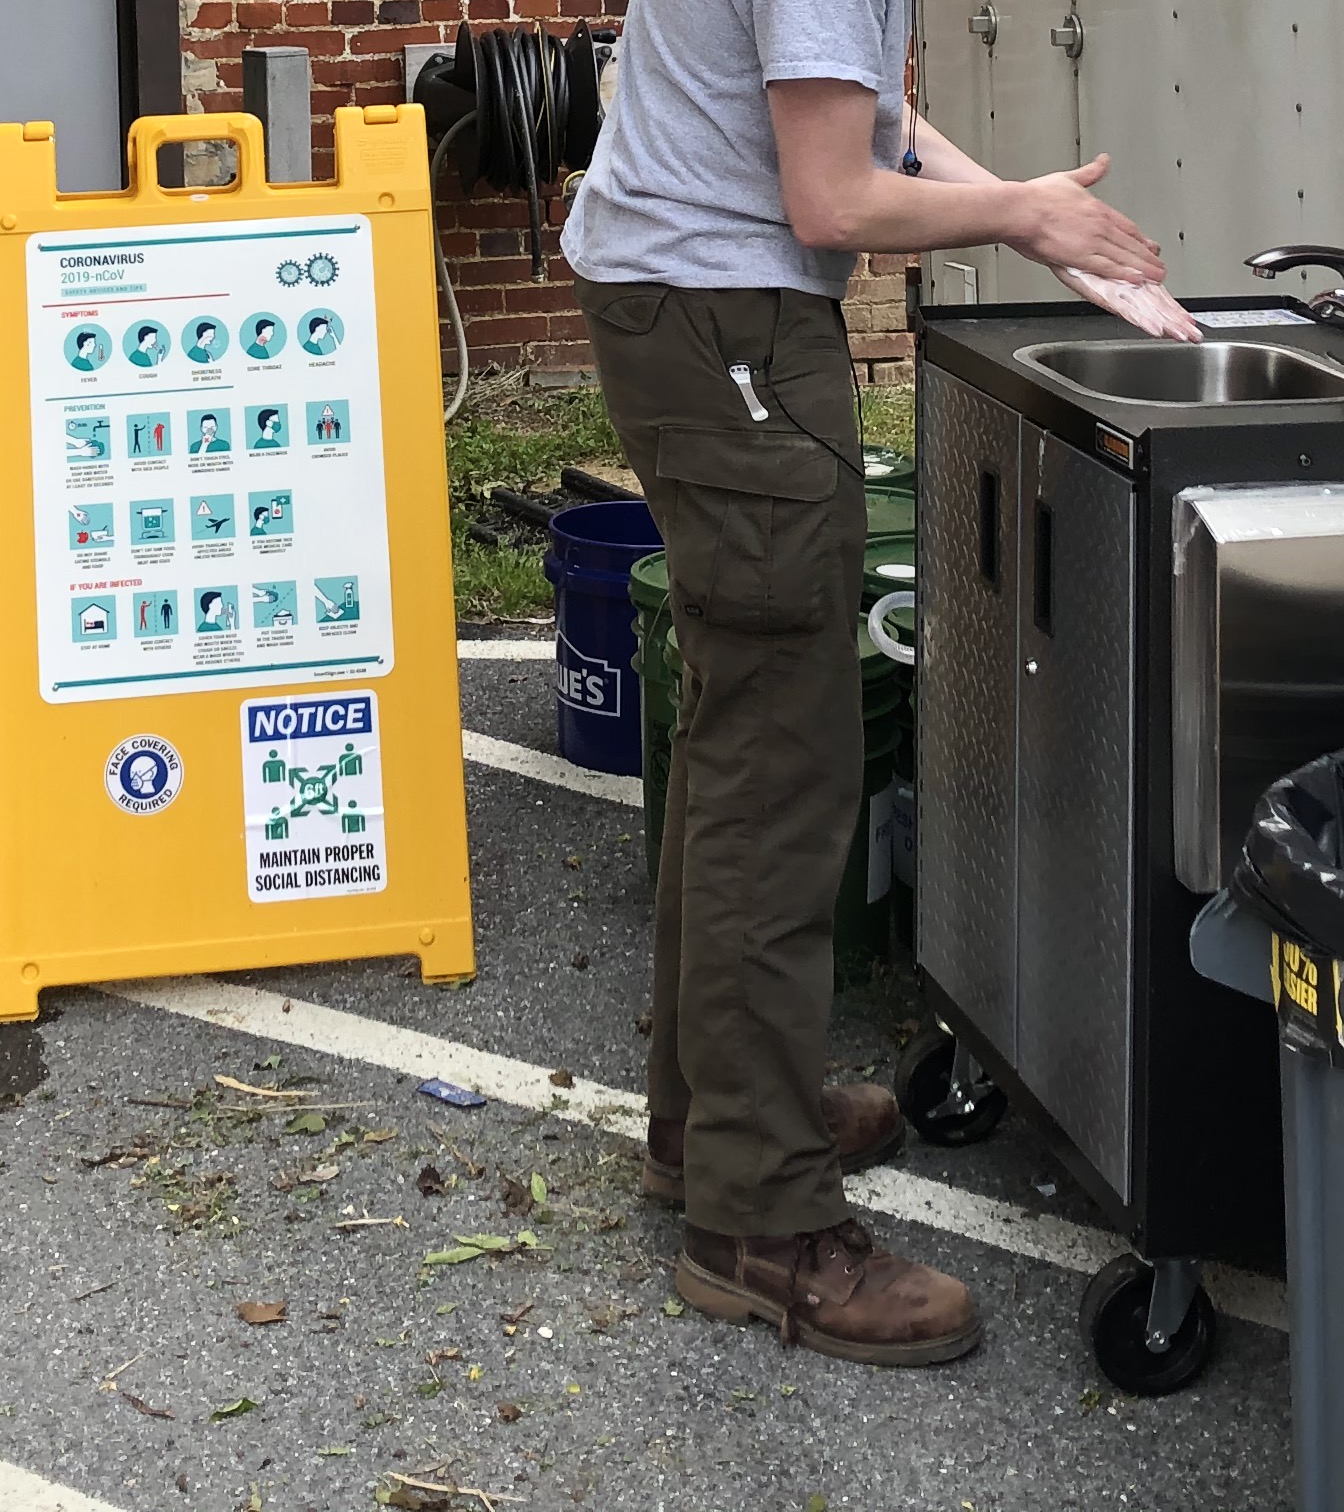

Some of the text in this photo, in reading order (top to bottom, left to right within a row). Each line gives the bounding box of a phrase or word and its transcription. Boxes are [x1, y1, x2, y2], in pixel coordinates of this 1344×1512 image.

[60, 253, 145, 268] CORONAVIRUS
[61, 269, 125, 284] 2019-nCoV
[61, 310, 98, 318] SYMPTOMS
[64, 404, 106, 412] PREVENTION
[94, 581, 106, 589] ARE
[110, 579, 142, 588] INFECTED
[254, 703, 366, 738] NOTICE
[109, 739, 178, 776] FACE COVERING
[304, 782, 324, 800] 6ft
[118, 789, 172, 813] REQUIRED
[259, 843, 374, 869] MAINTAIN PROPER
[255, 864, 380, 891] SOCIAL DISTANCING
